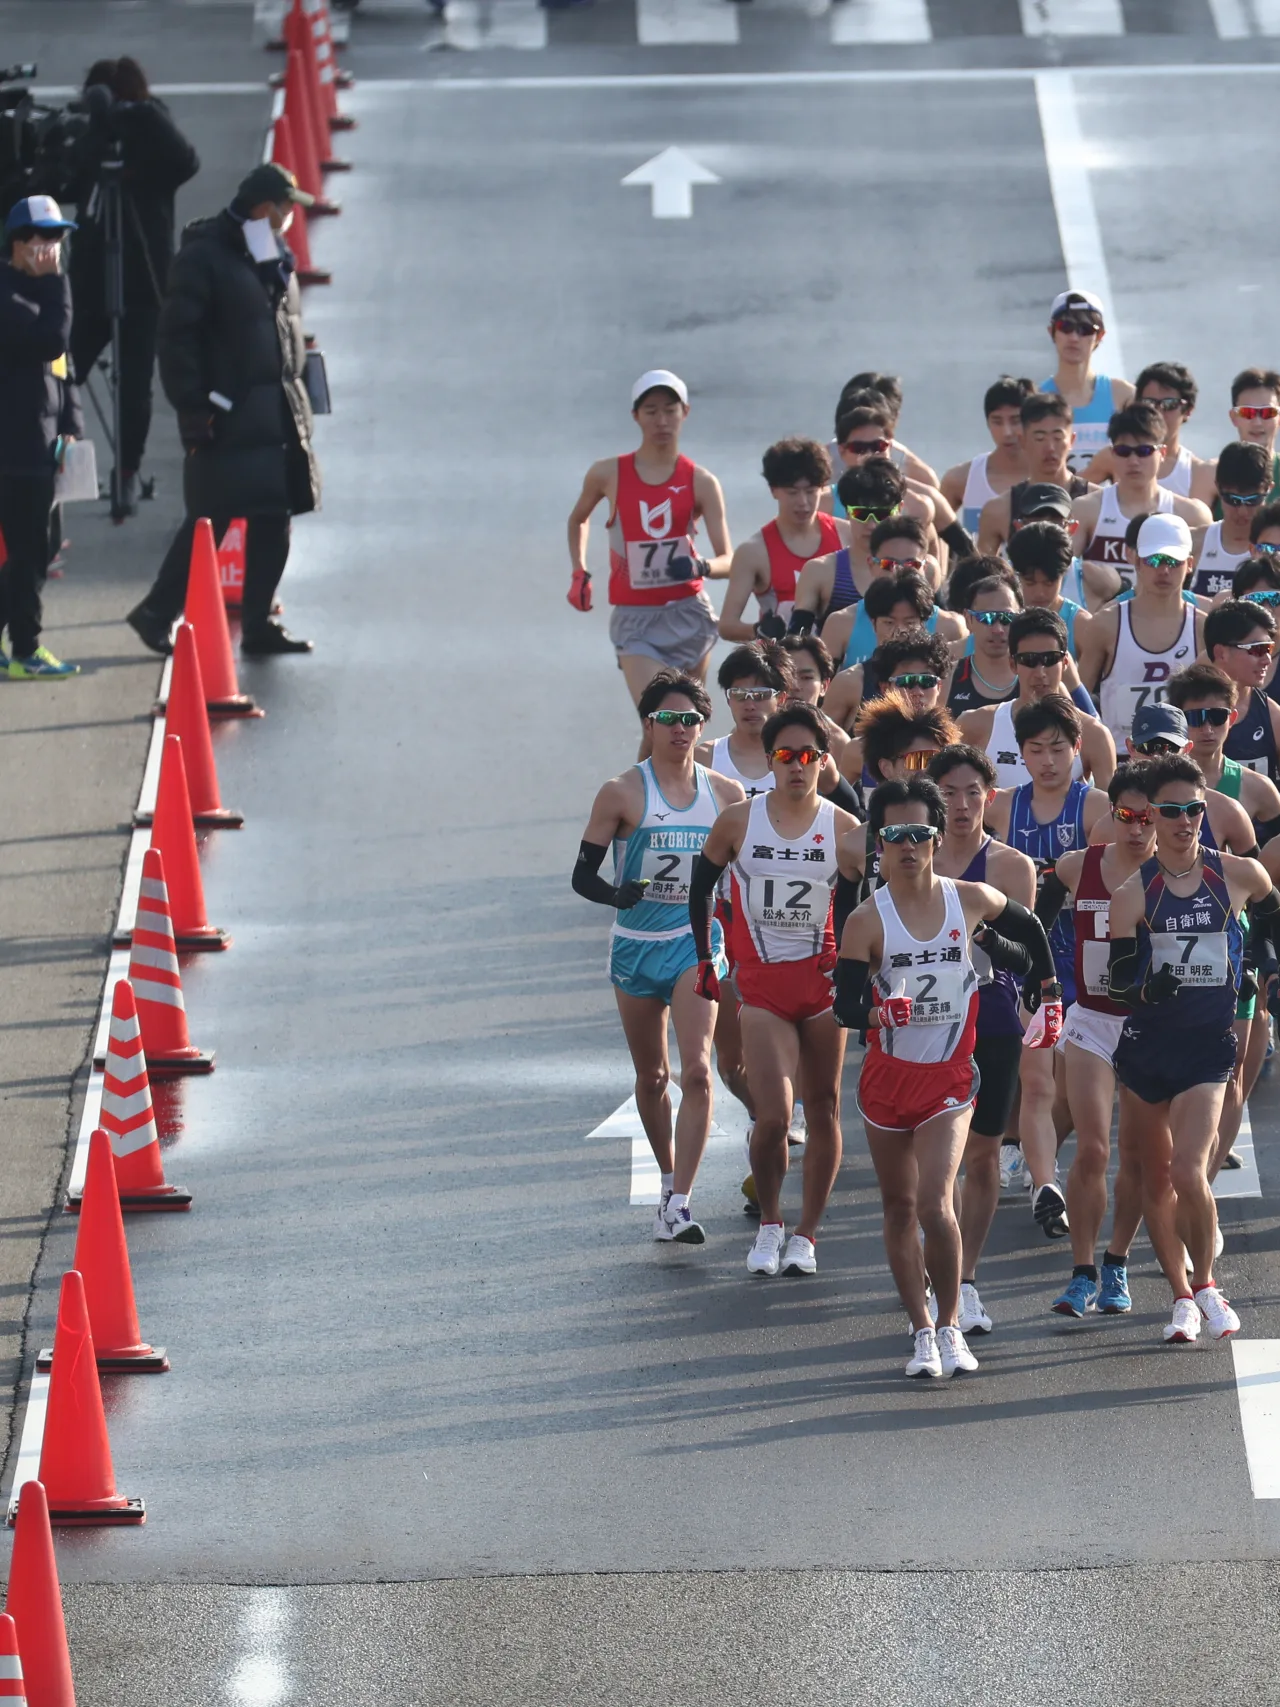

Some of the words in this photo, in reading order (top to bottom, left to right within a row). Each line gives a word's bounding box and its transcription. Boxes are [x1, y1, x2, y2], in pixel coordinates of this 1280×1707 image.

[639, 541, 679, 569] 77
[752, 845, 826, 862] 富士通
[653, 882, 675, 893] 向井
[764, 880, 812, 909] 12
[762, 908, 786, 920] 松永
[790, 909, 812, 921] 大介
[1165, 911, 1212, 932] 自衛隊
[889, 947, 962, 968] 富士通
[1176, 935, 1199, 963] 7
[1190, 964, 1213, 976] 明宏
[915, 973, 939, 1003] 2
[929, 1001, 951, 1015] 英輝
